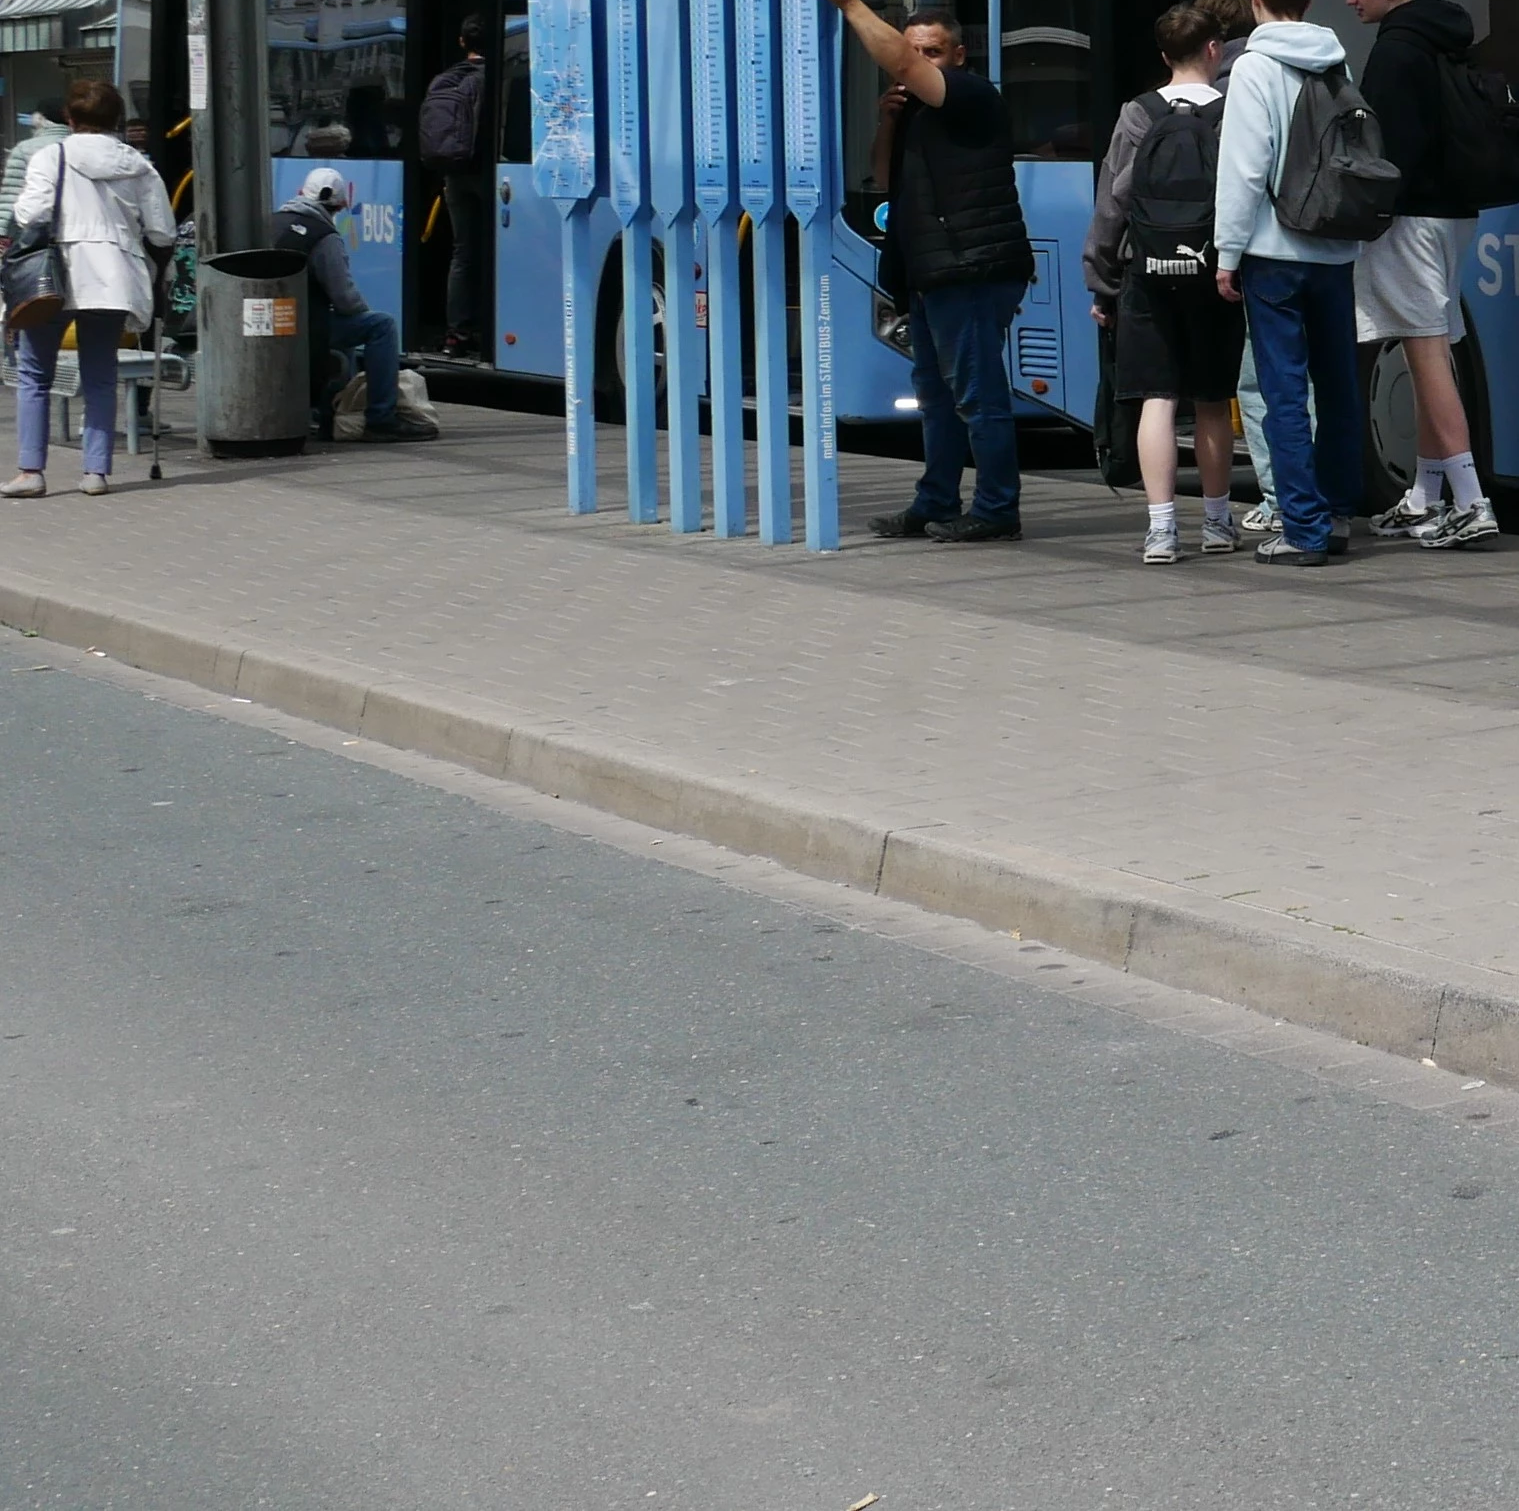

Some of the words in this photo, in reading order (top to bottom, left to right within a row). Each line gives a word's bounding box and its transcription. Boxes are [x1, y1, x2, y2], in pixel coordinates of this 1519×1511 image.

[363, 203, 395, 244] BUS
[1146, 257, 1198, 275] PUMA
[818, 274, 831, 382] STADTBUS-Zentrum
[819, 384, 831, 398] im
[820, 400, 832, 429] Infos
[821, 431, 832, 459] mehr
